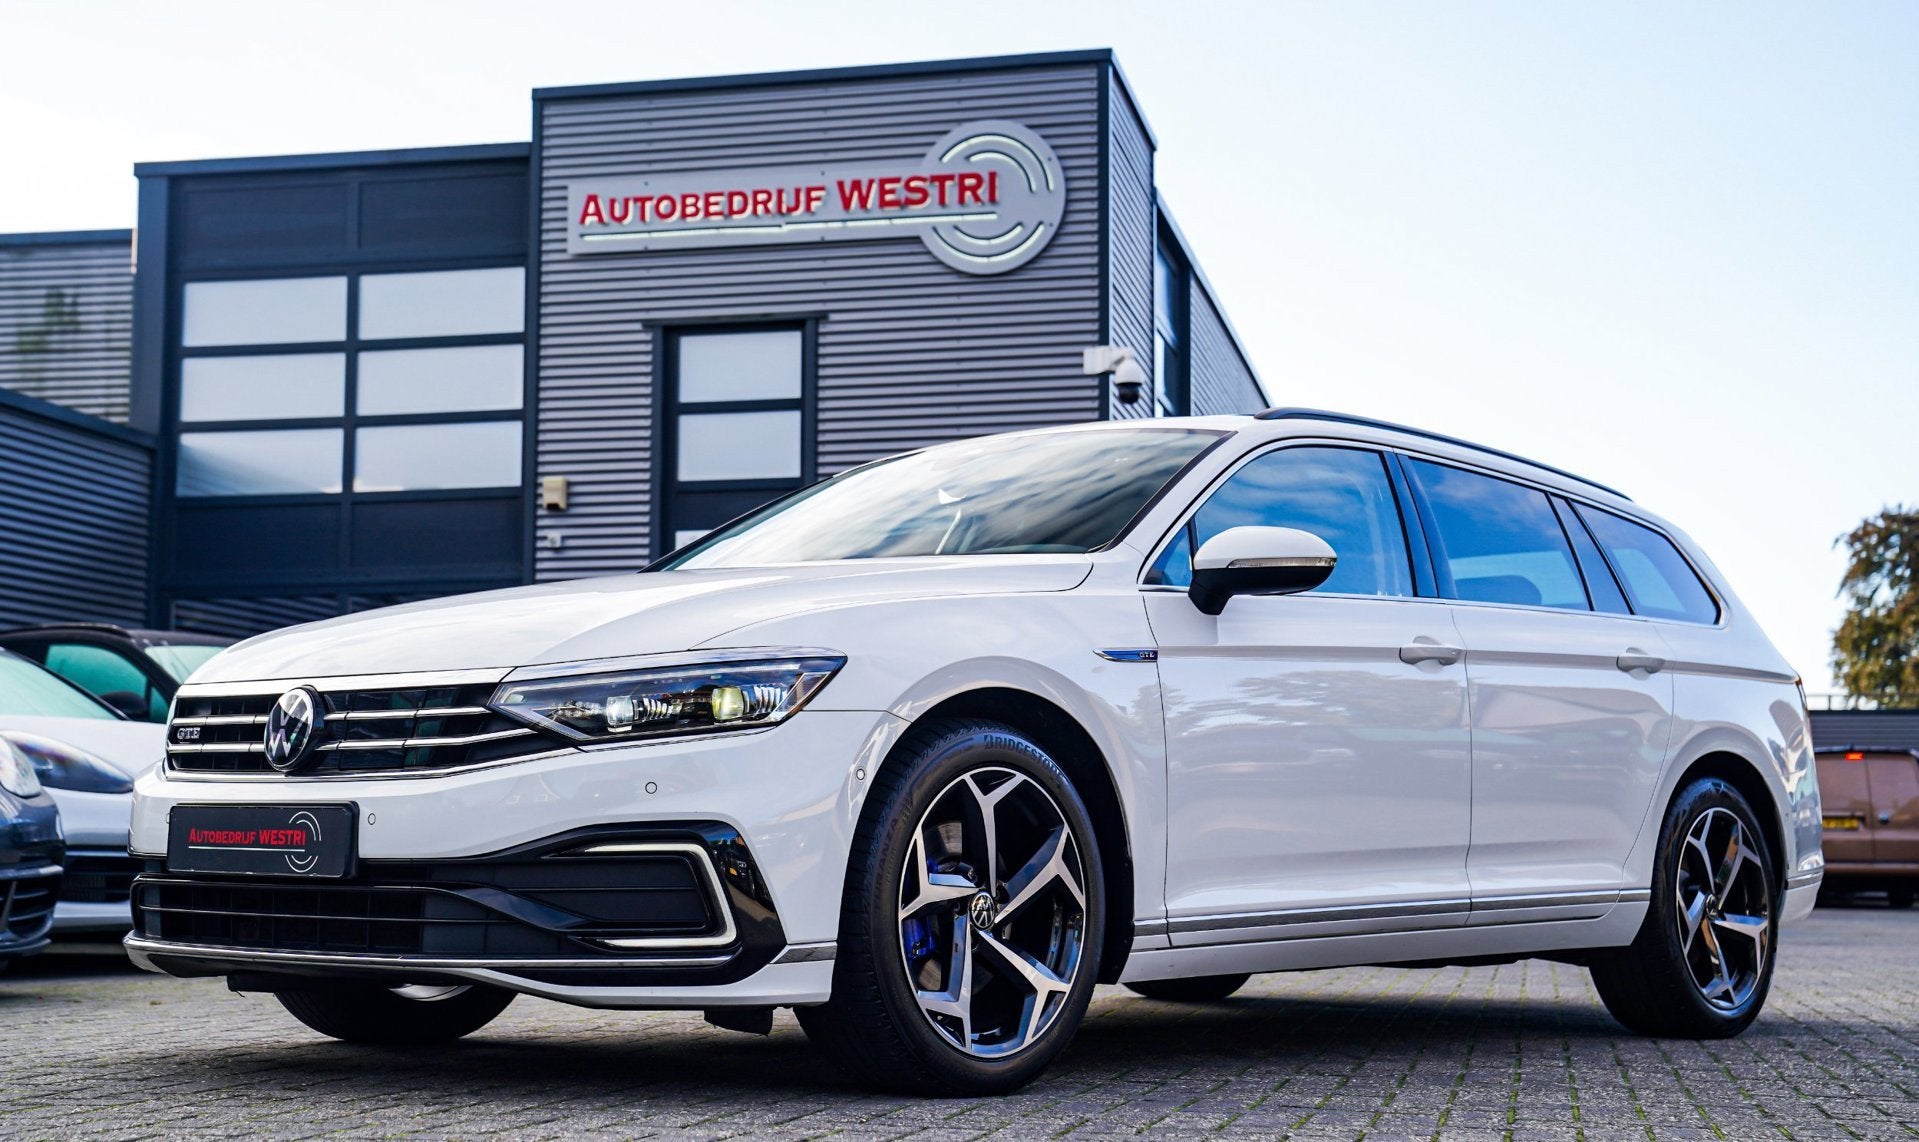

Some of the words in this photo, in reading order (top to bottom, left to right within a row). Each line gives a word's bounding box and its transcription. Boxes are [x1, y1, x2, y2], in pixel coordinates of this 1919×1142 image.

[580, 186, 826, 226] AUTOBEDRIJF
[836, 171, 998, 209] WESTRI
[177, 727, 200, 740] GTE
[188, 828, 256, 845] AUTOBEDRIJF
[259, 829, 306, 846] WESTRI
